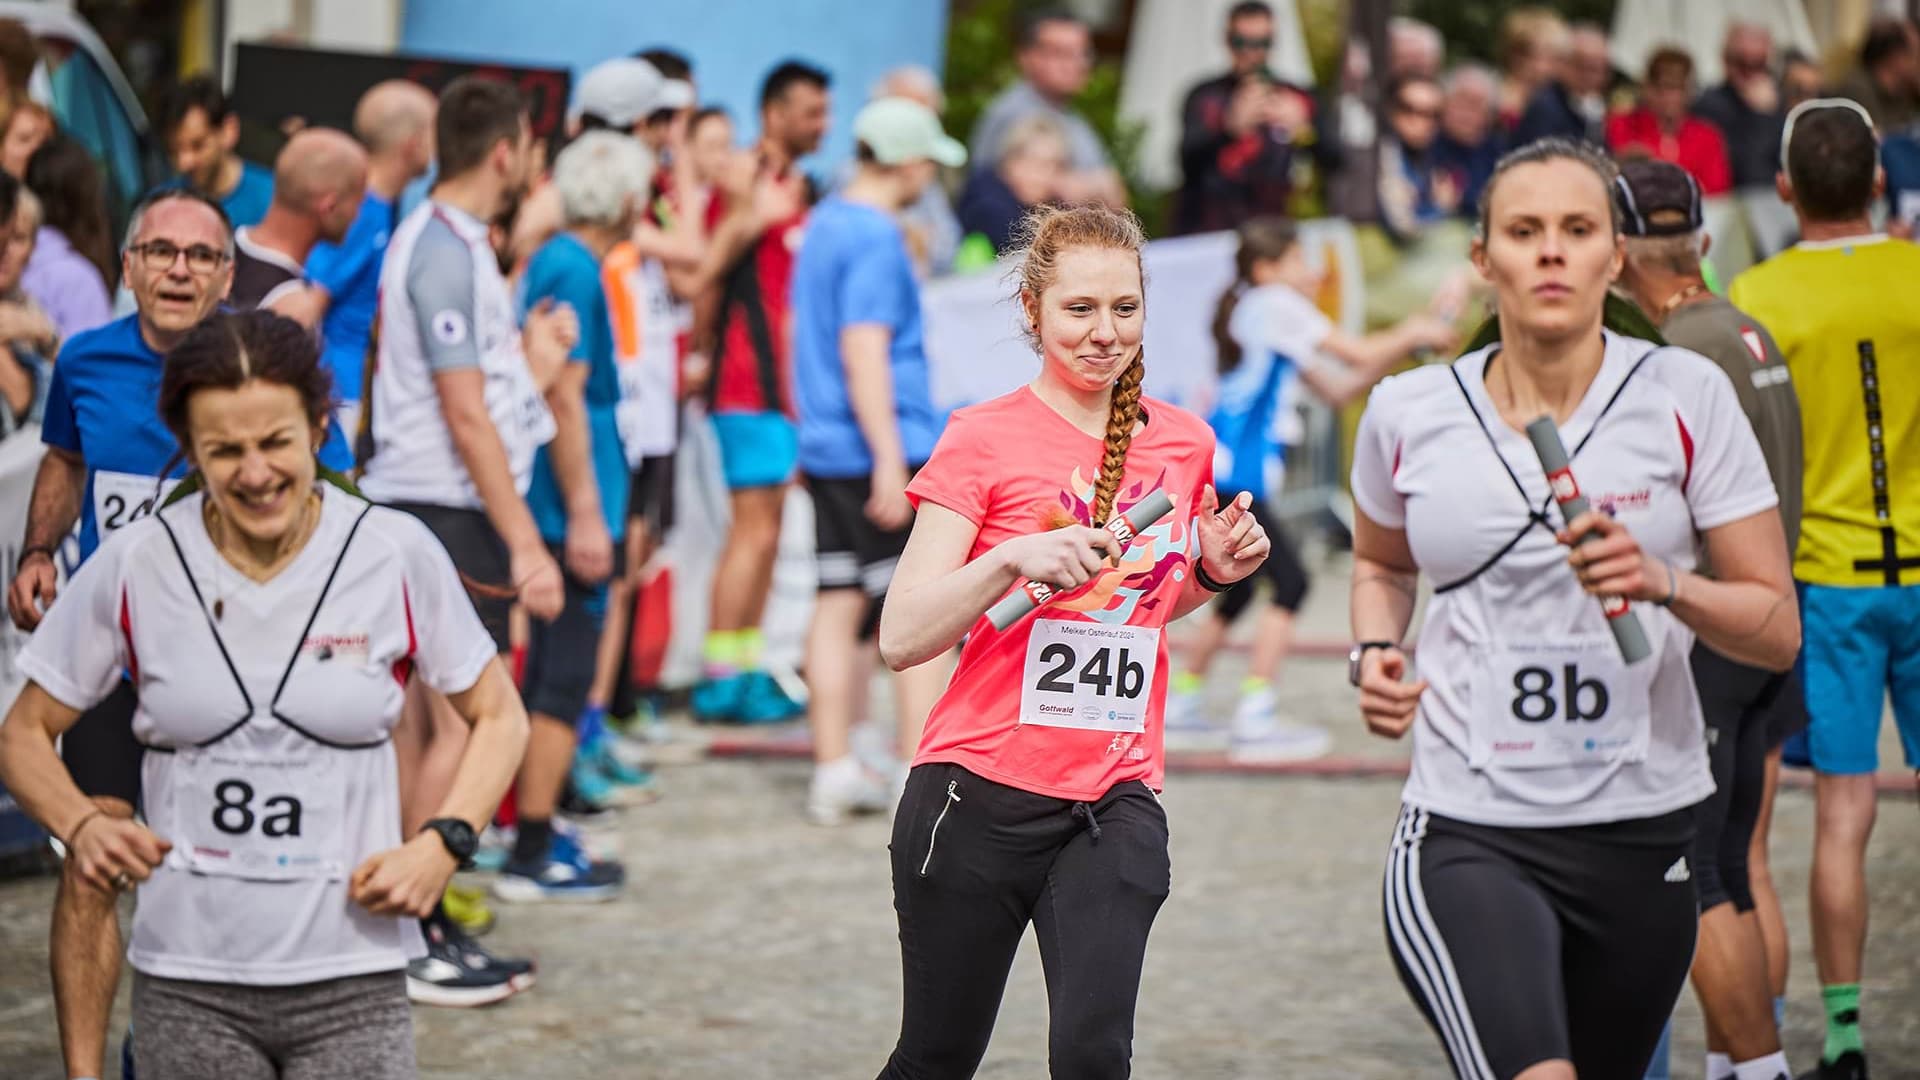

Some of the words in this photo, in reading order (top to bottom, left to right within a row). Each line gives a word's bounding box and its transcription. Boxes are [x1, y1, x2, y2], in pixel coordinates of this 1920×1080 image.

[1035, 643, 1144, 699] 24b
[1512, 664, 1609, 722] 8b
[1039, 704, 1074, 714] Gottwald
[212, 779, 302, 837] 8a
